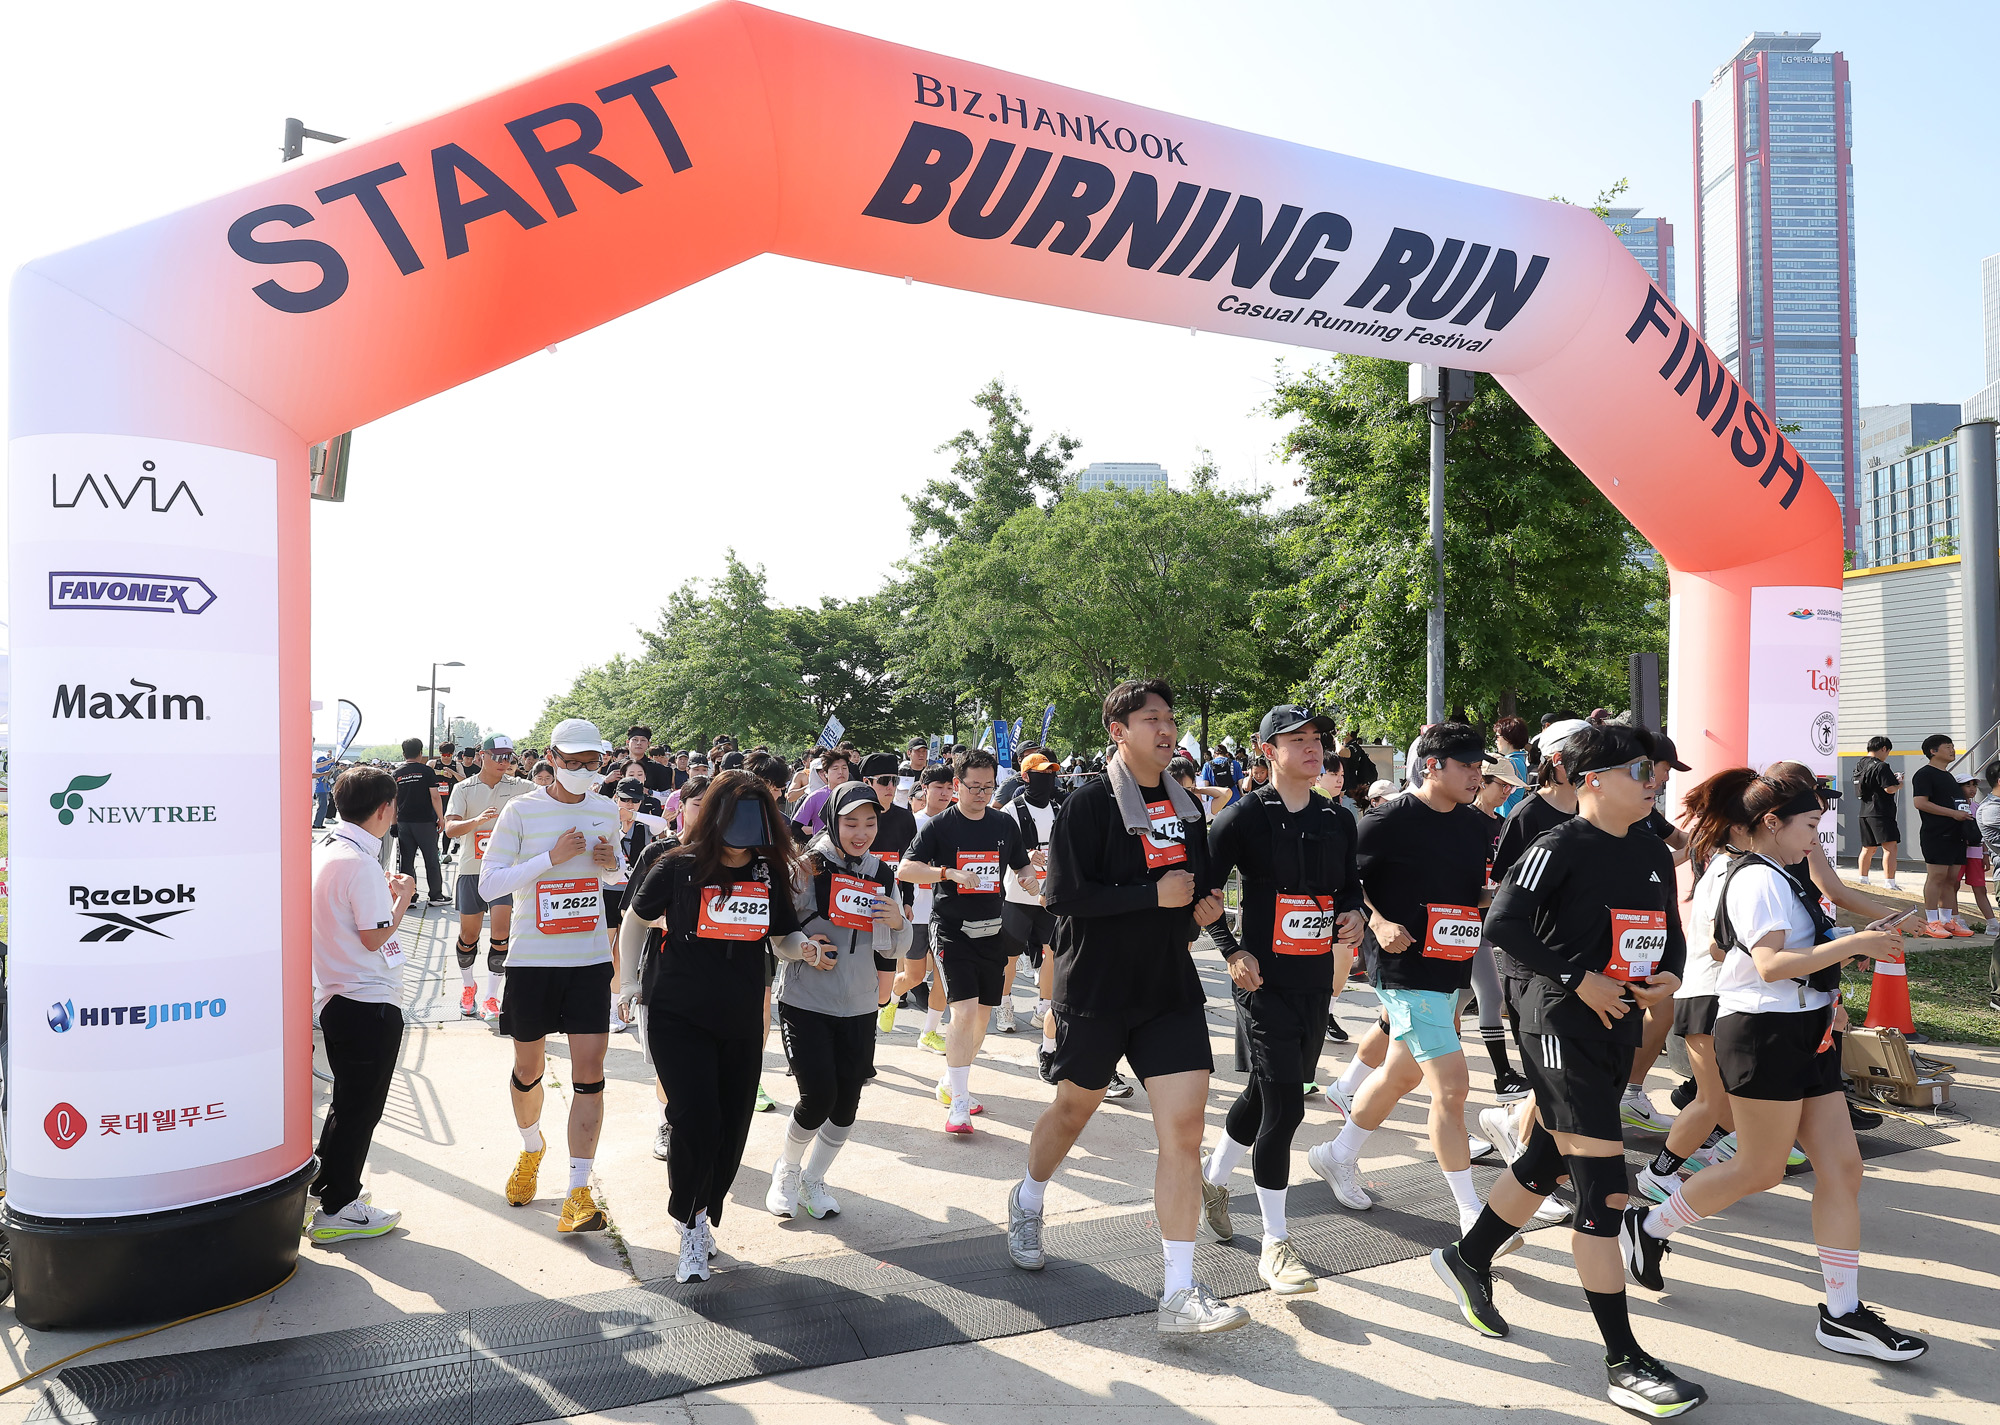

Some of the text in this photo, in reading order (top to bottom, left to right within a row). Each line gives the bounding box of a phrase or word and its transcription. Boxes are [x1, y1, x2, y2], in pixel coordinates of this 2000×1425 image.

[228, 64, 693, 314] START
[862, 120, 1550, 331] BURNING RUN
[1216, 295, 1493, 354] Casual Running Festival
[1625, 283, 1805, 510] FINISH
[58, 581, 190, 606] FAVONEX
[52, 678, 204, 720] Maxim
[88, 805, 217, 824] NEWTREE
[69, 883, 196, 910] Reebok
[551, 896, 598, 910] M 2622
[715, 901, 768, 915] W 4382
[841, 895, 851, 903] W
[1289, 918, 1300, 928] M
[1439, 924, 1480, 937] M 2068
[1625, 935, 1665, 950] M 2644
[99, 1102, 227, 1137] 롯데웰푸드
